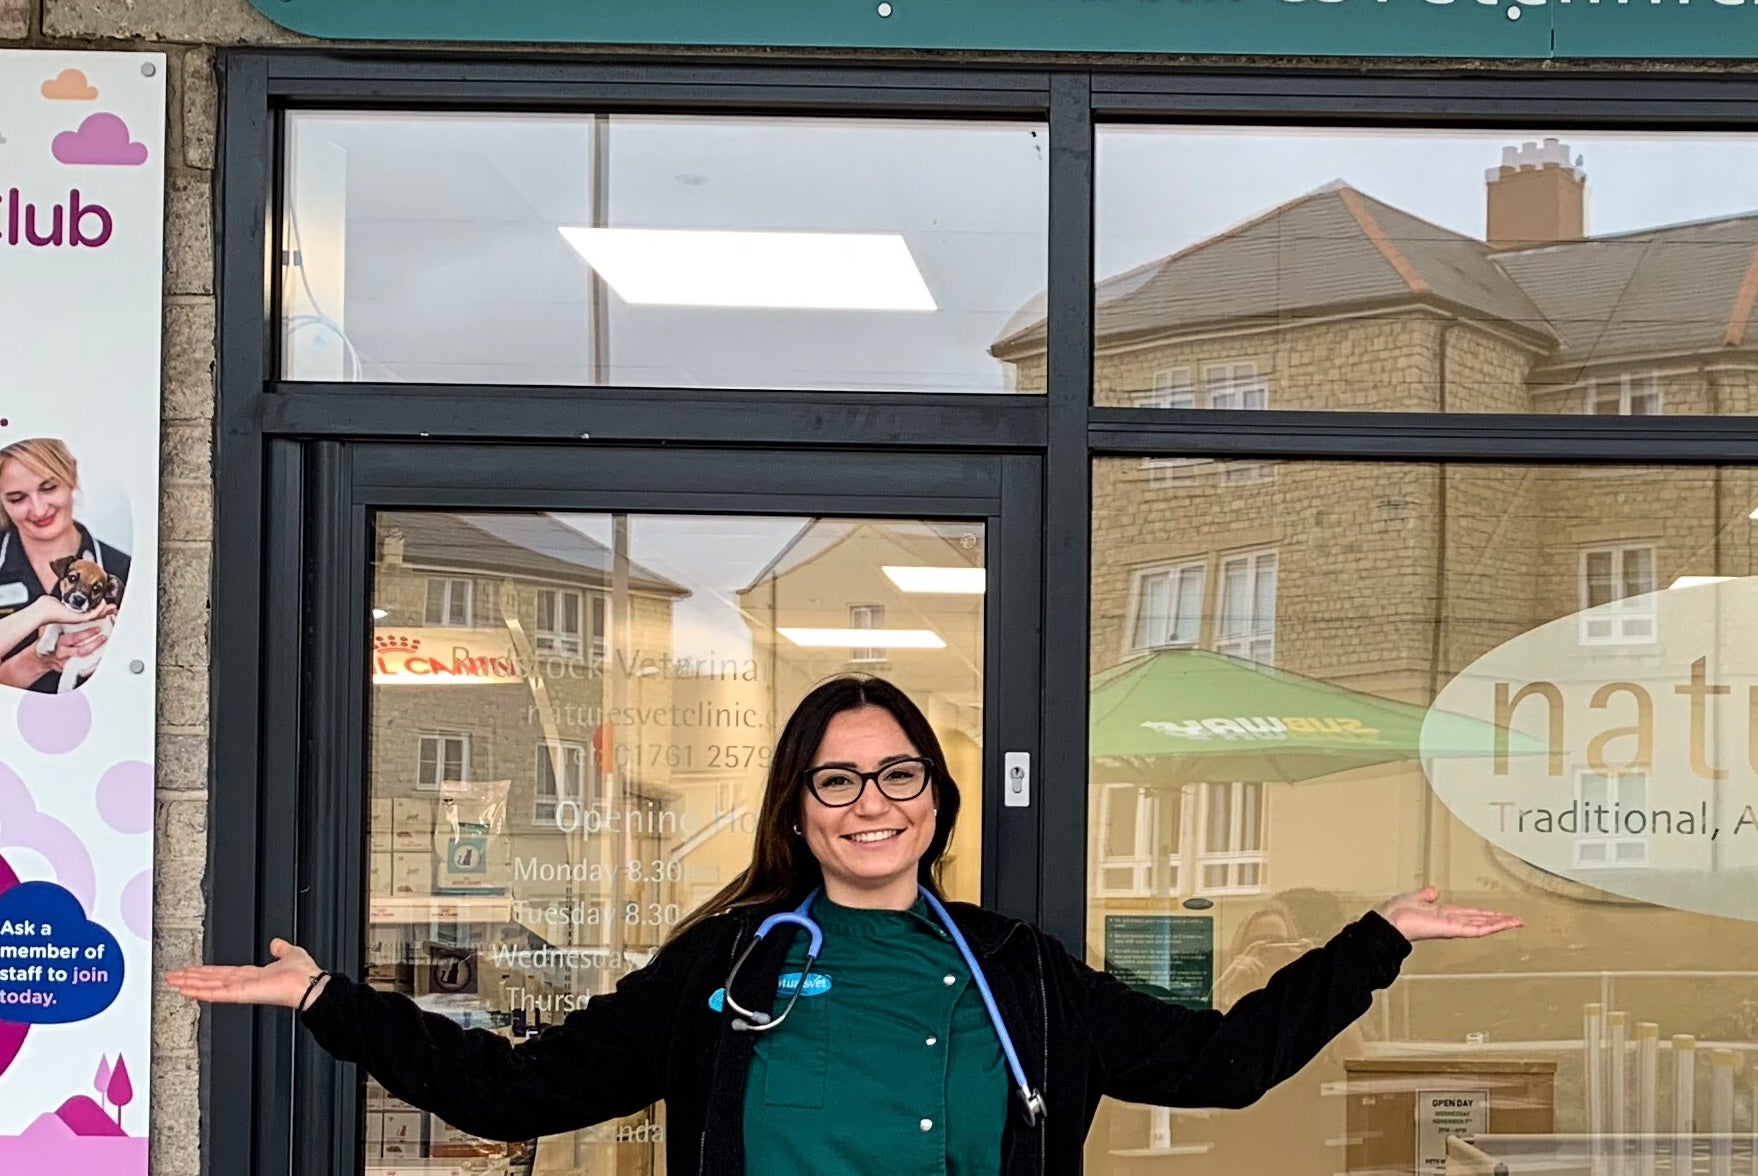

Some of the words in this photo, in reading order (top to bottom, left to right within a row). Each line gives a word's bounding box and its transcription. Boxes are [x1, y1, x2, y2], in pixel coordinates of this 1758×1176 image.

[0, 187, 113, 248] lub
[1493, 656, 1758, 780] nat
[1489, 799, 1720, 840] Traditional,
[0, 920, 35, 935] Ask
[41, 924, 51, 936] a
[0, 943, 79, 959] member
[84, 944, 105, 960] of
[0, 965, 42, 981] staff
[47, 967, 67, 982] to
[72, 967, 108, 984] join
[0, 989, 56, 1007] today.
[1432, 1099, 1455, 1107] OPEN
[1457, 1099, 1473, 1107] DAY
